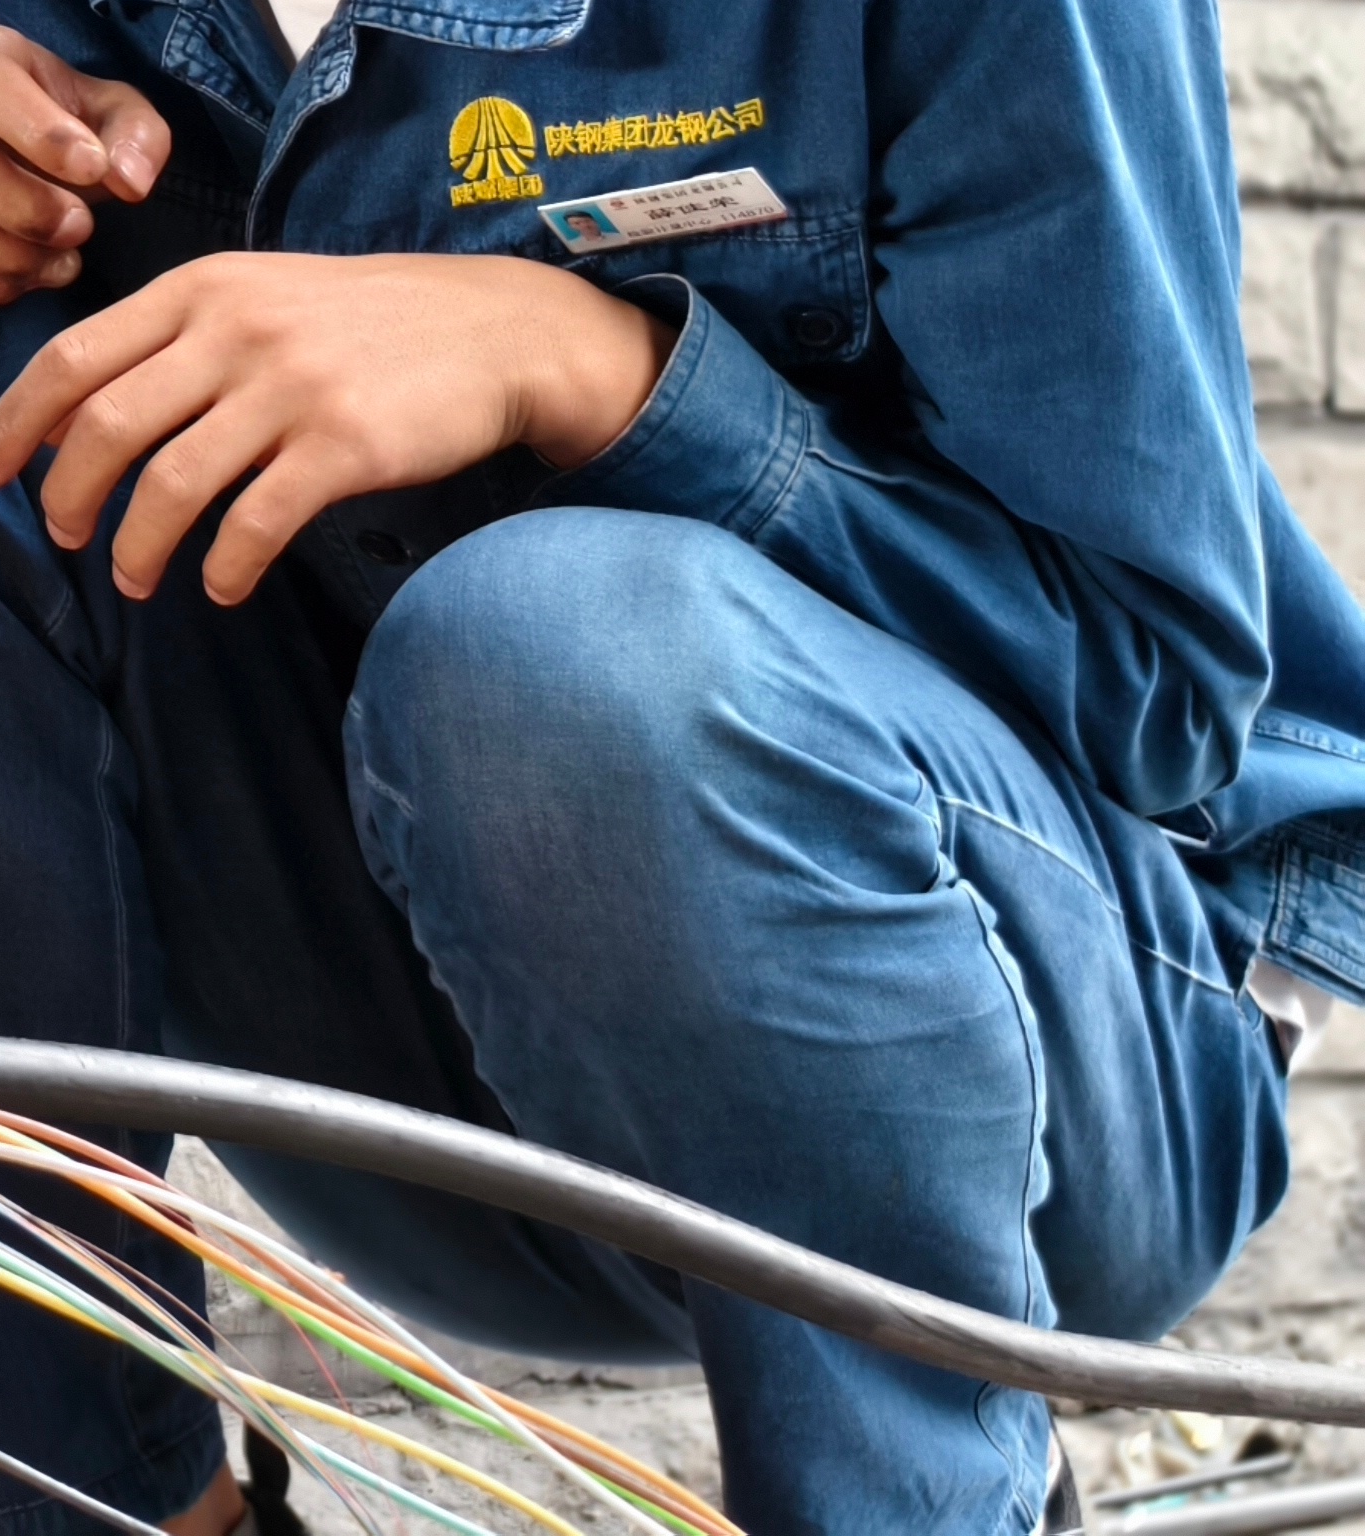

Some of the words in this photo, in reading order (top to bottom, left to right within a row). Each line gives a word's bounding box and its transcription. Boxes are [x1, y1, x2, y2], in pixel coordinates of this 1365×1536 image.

[544, 98, 764, 158] 陕钢集团龙钢公司
